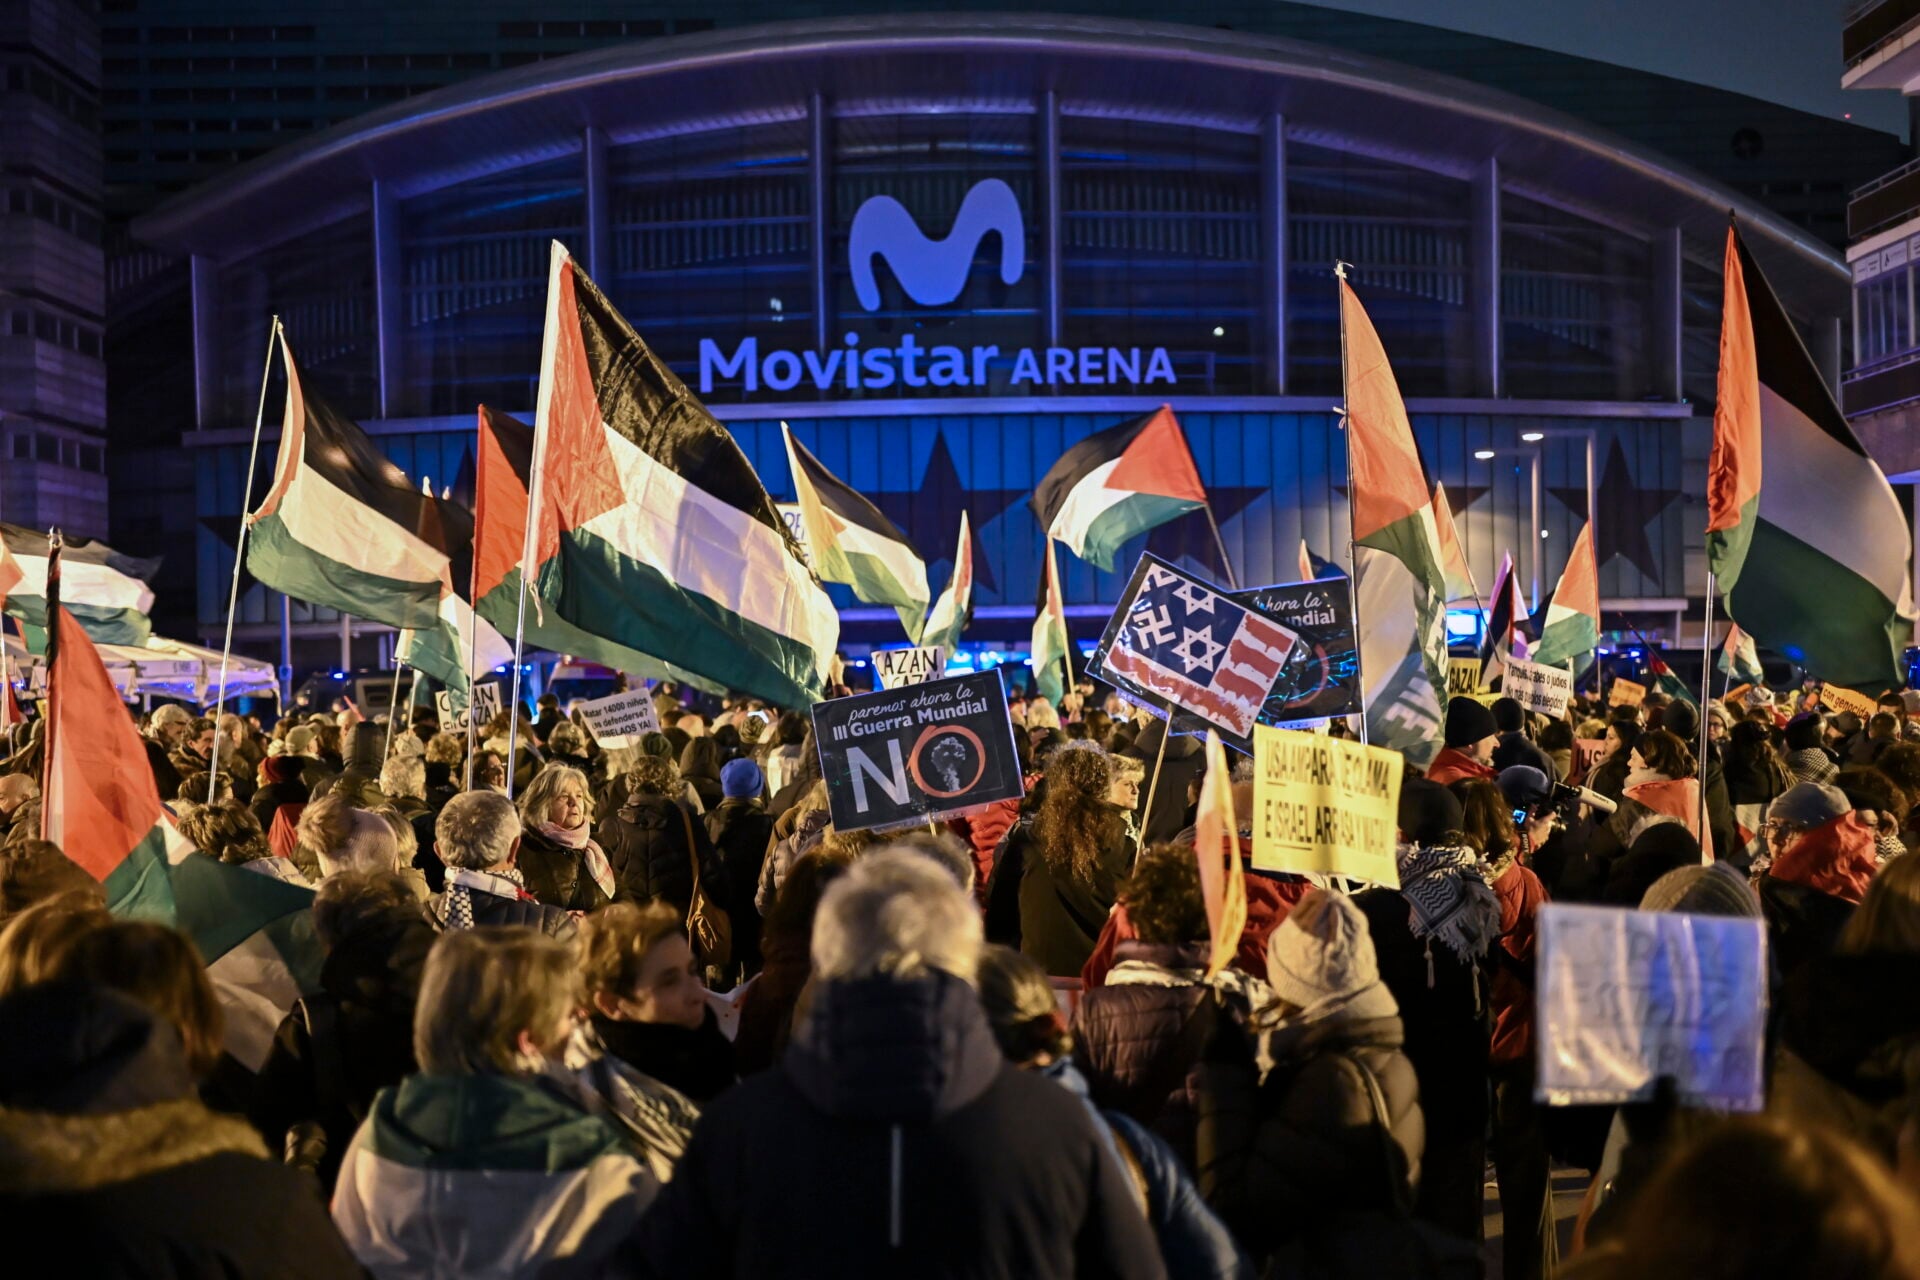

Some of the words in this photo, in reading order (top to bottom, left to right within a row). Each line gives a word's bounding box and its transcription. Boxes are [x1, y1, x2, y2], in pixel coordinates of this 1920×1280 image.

[700, 331, 999, 394] Movistar
[1010, 347, 1177, 385] ARENA
[1303, 591, 1321, 609] la
[848, 700, 906, 727] paremos
[910, 691, 952, 709] ahora
[956, 683, 974, 699] la
[1823, 689, 1835, 702] con
[603, 701, 626, 714] 14000
[850, 714, 913, 737] Guerra
[917, 697, 988, 724] Mundial
[603, 708, 649, 728] defenderse?
[637, 719, 652, 731] YA!
